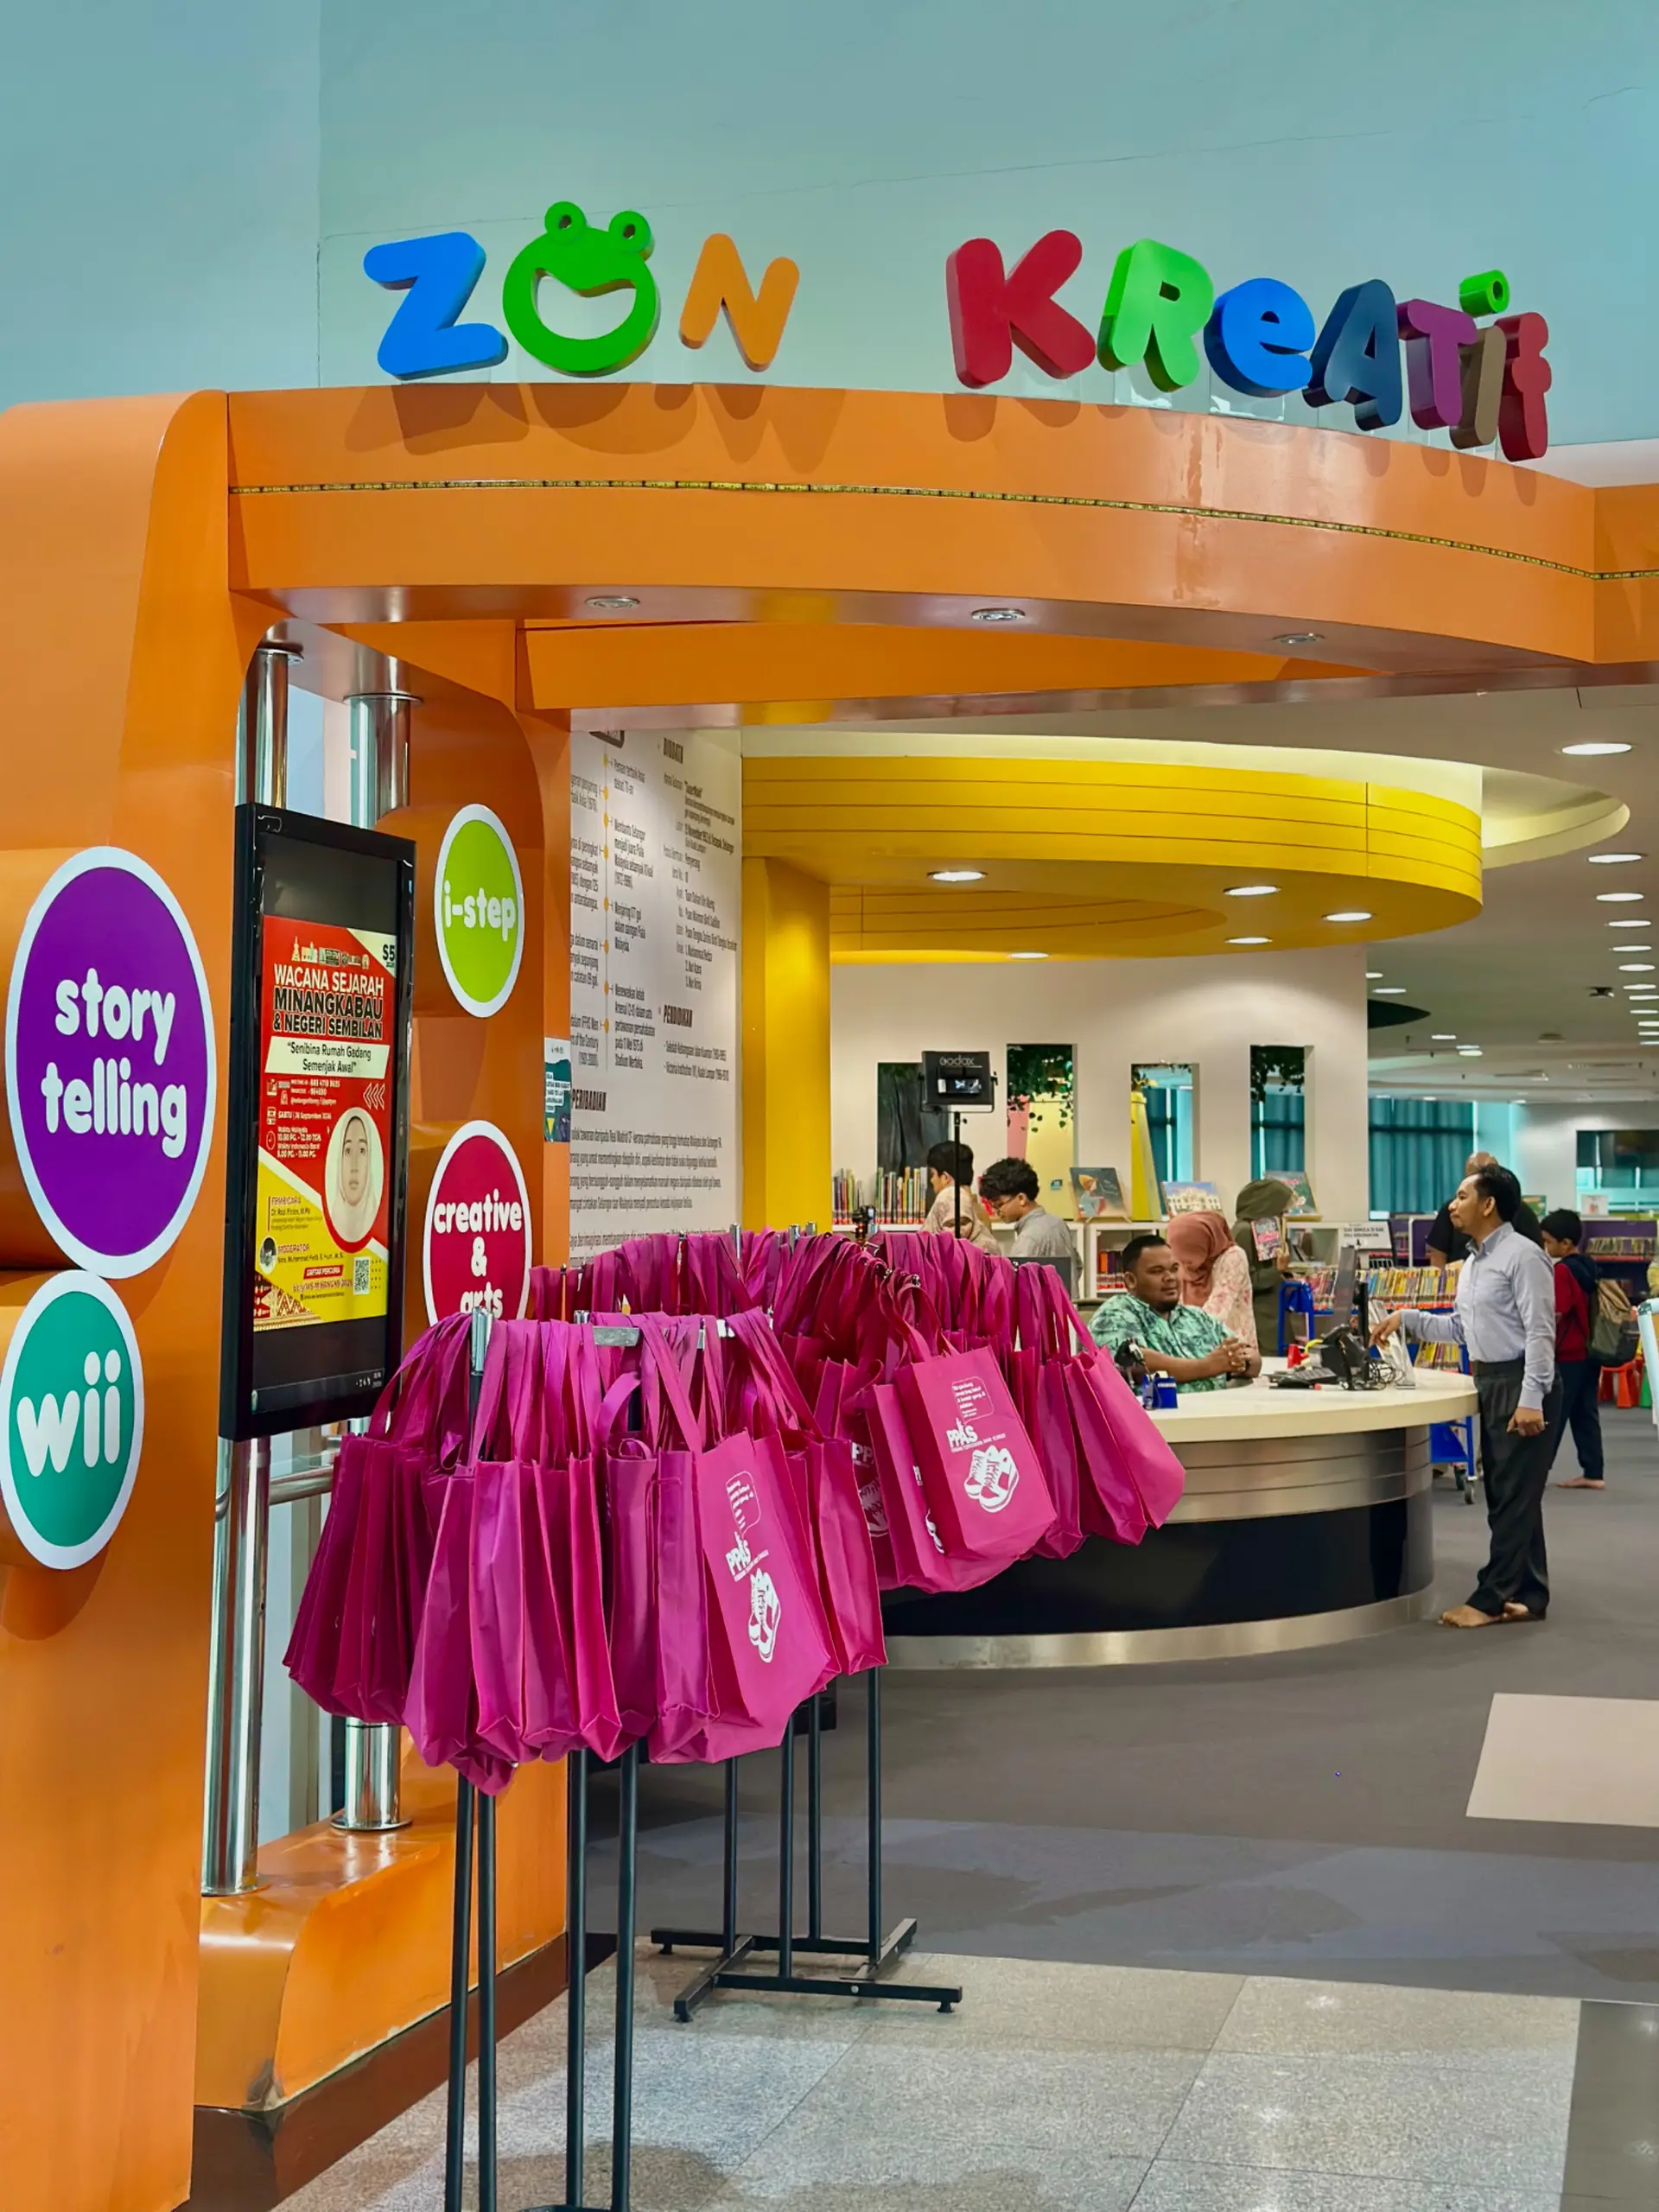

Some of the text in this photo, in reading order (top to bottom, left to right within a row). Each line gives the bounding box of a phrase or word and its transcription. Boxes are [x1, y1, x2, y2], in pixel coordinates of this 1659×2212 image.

[444, 880, 516, 942] i-step
[274, 963, 385, 997] WACANA SEJARAH
[55, 968, 175, 1065] story
[273, 986, 383, 1020] MINANGKABAU
[273, 1011, 382, 1039] & NEGERI SEMBILAN
[302, 1058, 335, 1074] Semenjak
[322, 1044, 345, 1057] Rumah
[346, 1046, 372, 1061] Gadang
[41, 1058, 187, 1158] telling
[434, 1188, 522, 1234] creative
[471, 1236, 487, 1276] &
[461, 1281, 503, 1319] arts
[16, 1349, 121, 1477] wii
